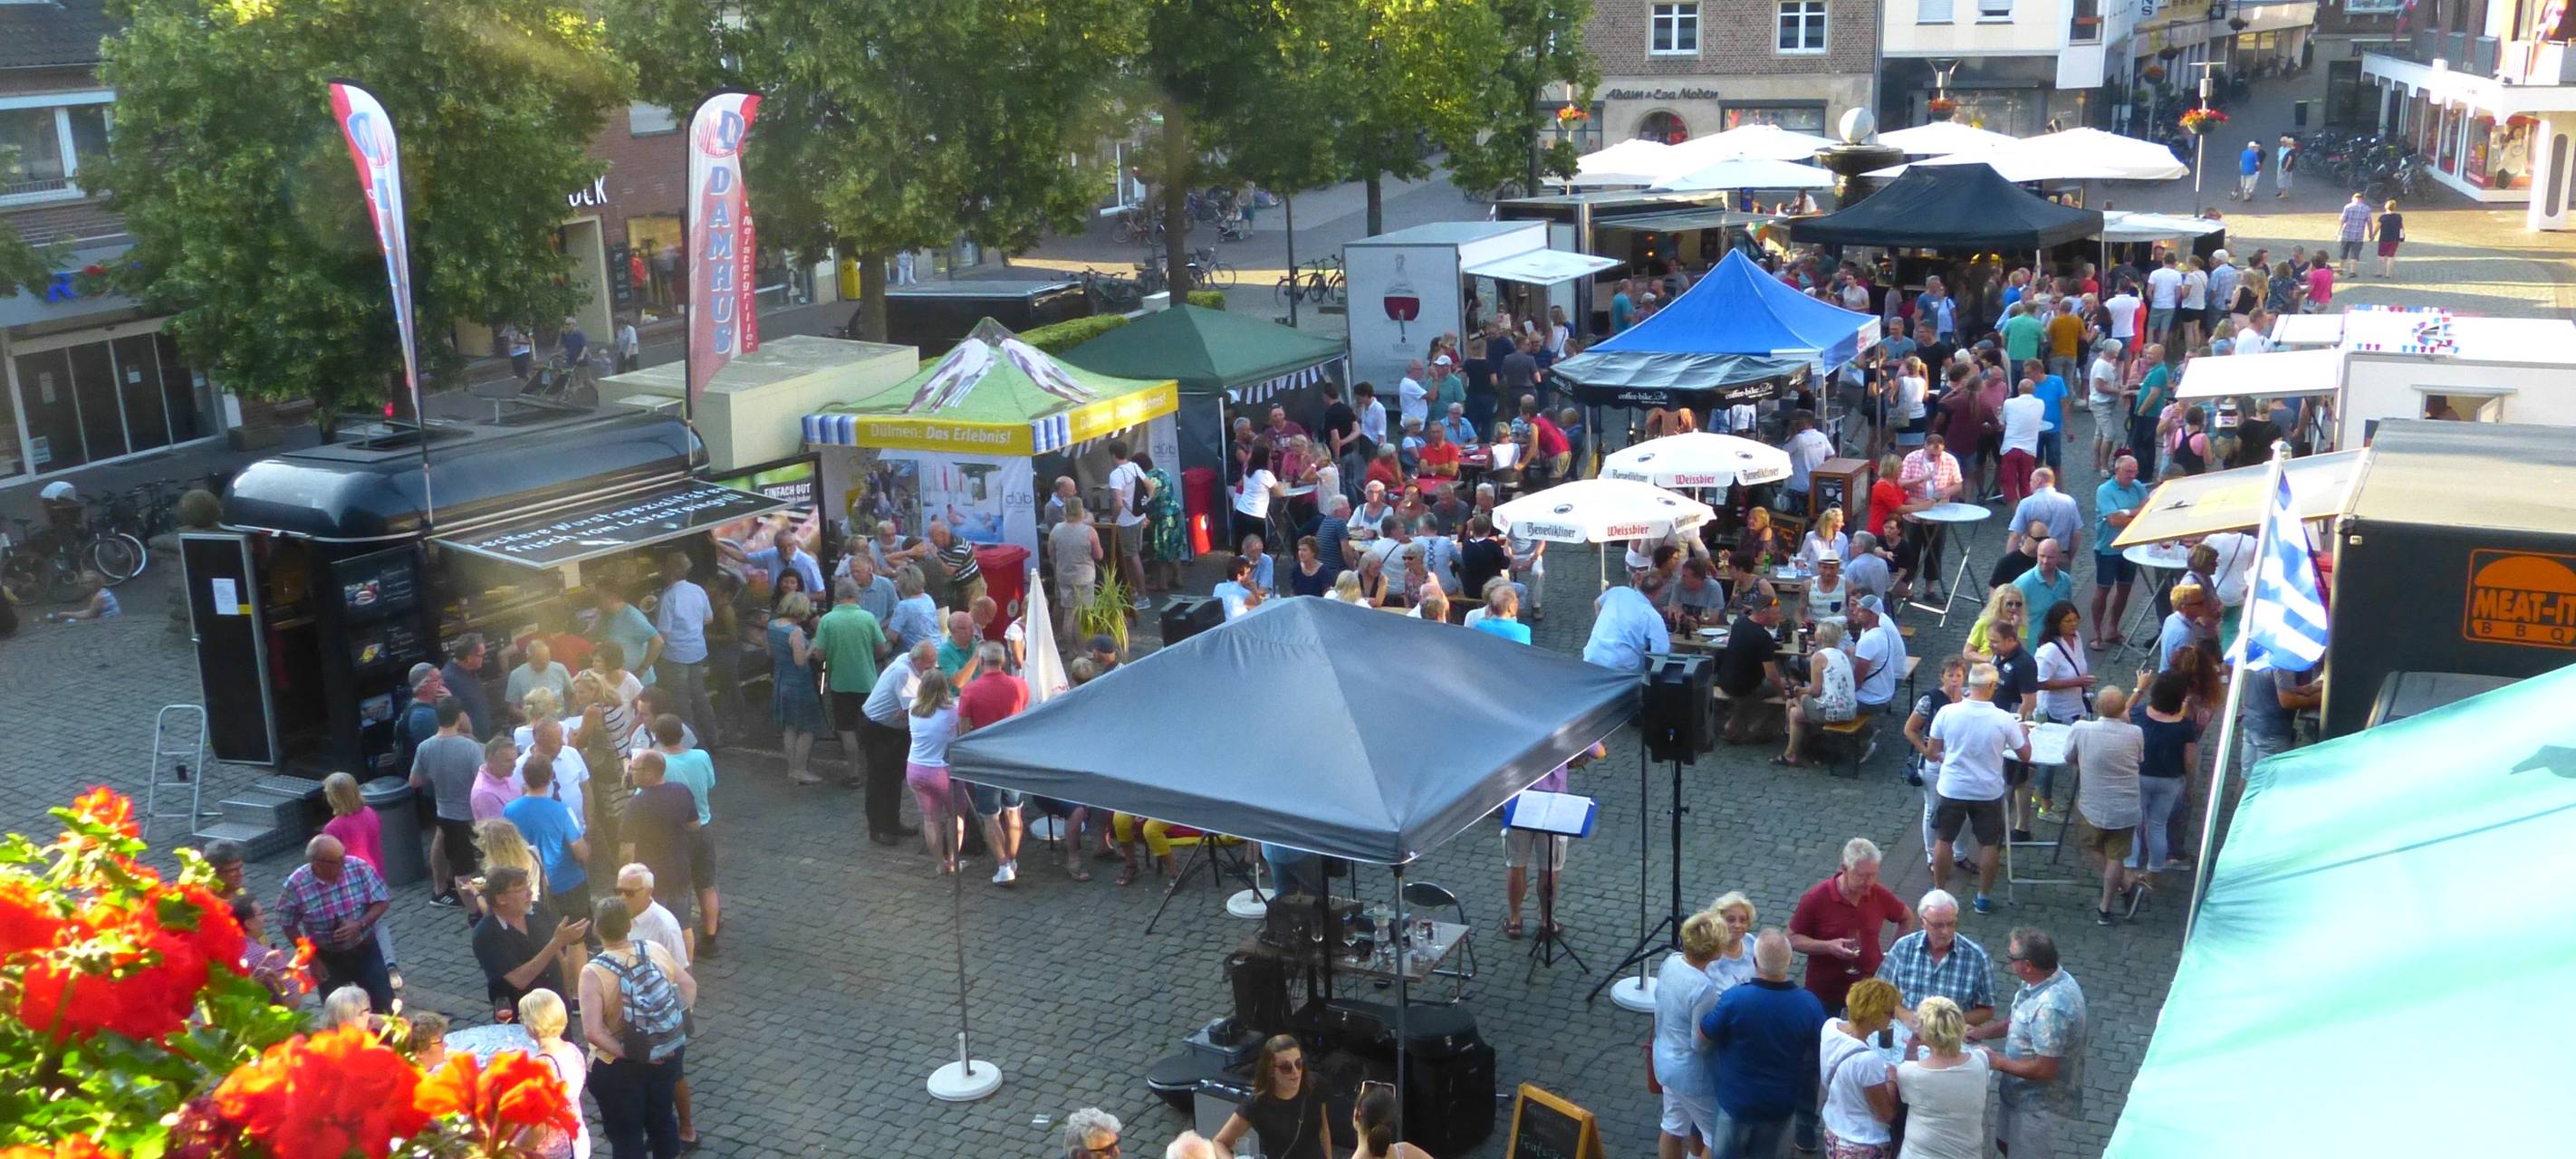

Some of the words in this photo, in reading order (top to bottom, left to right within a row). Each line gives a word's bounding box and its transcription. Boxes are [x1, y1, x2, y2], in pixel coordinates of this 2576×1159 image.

[1677, 88, 1718, 100] Moden
[708, 166, 735, 355] DAMHUS
[870, 423, 922, 438] Dülmen:
[927, 426, 949, 440] Das
[953, 427, 1011, 445] Erlebnis!
[1675, 474, 1716, 484] Weissbier
[796, 483, 811, 494] GUT
[1607, 525, 1649, 536] Weissbier
